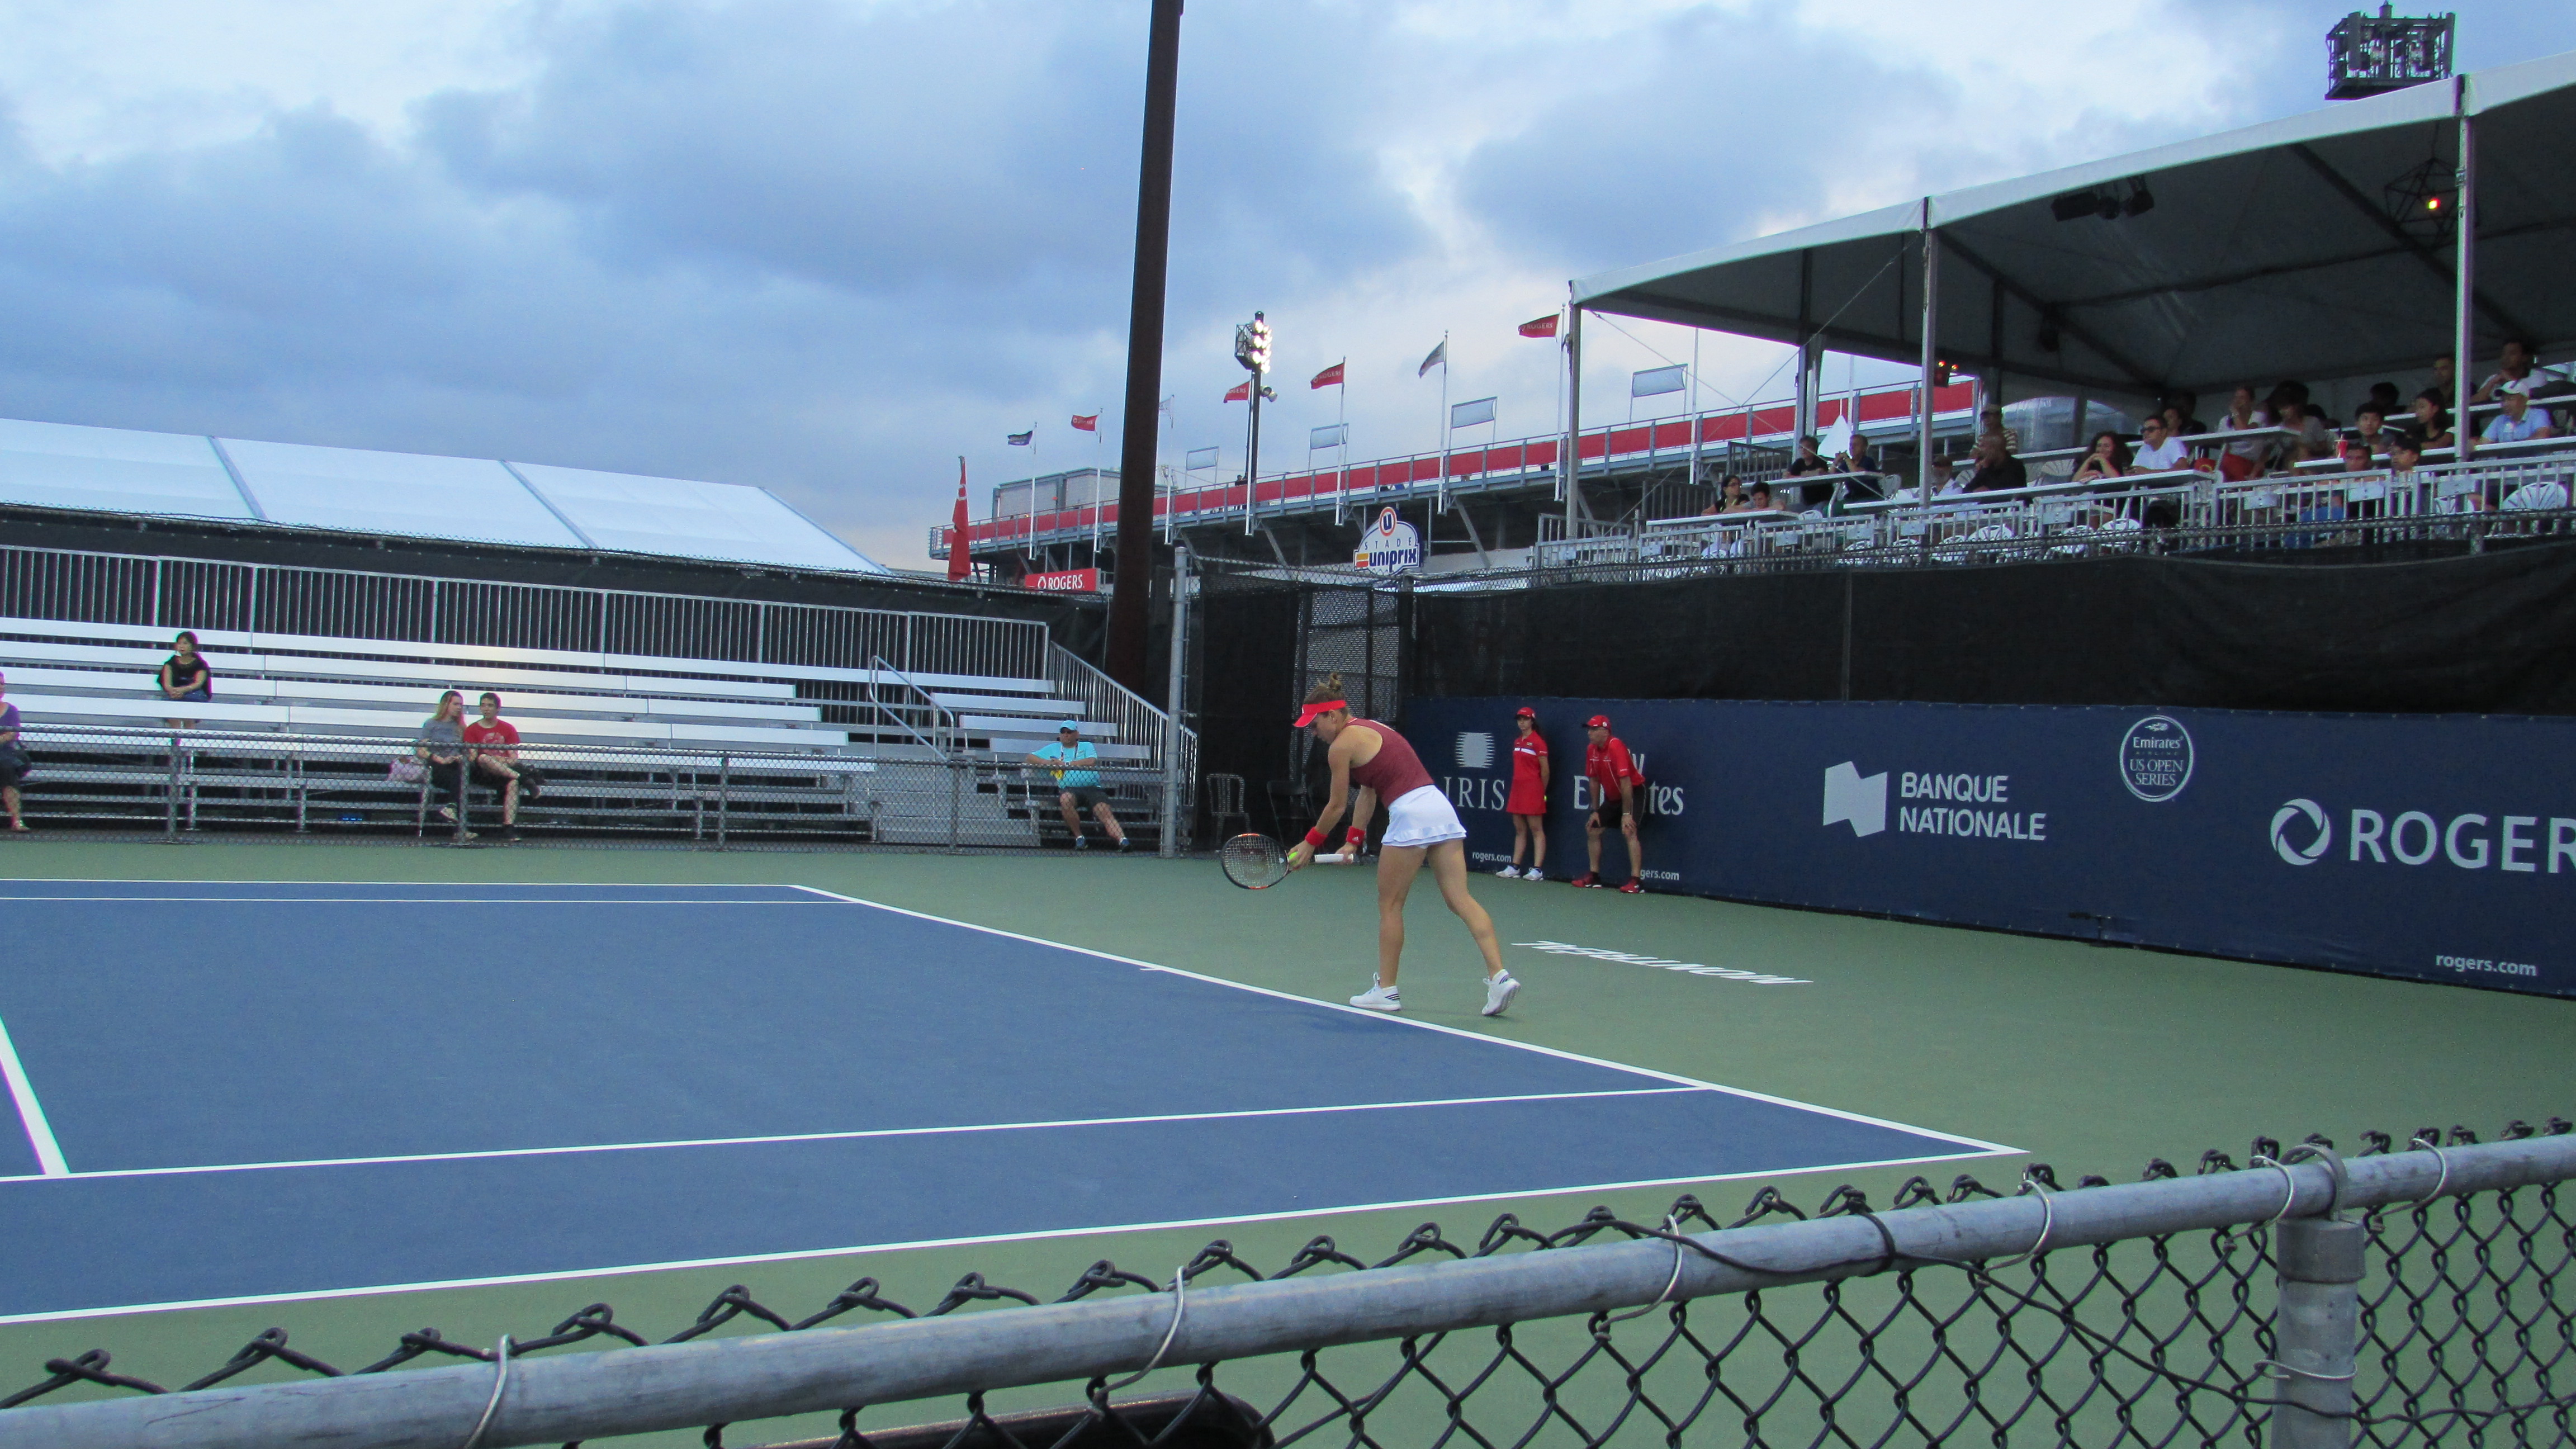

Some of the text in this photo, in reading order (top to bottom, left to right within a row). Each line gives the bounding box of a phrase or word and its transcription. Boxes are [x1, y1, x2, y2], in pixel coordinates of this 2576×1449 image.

[1365, 537, 1412, 550] STADE
[1370, 548, 1417, 573] uniprix
[1048, 574, 1083, 590] ROGERS
[2133, 737, 2180, 749] Emirates
[2130, 759, 2184, 772] US OPEN
[2135, 773, 2176, 785] SERIES
[1443, 776, 1505, 811] IRIS
[1574, 775, 1684, 816] Etes
[1901, 772, 2009, 803] BANQUE
[1900, 807, 2047, 840] NATIONALE
[1472, 851, 1511, 863] rogers.com
[1640, 869, 1679, 880] gers.com
[2436, 955, 2538, 977] rogers.com
